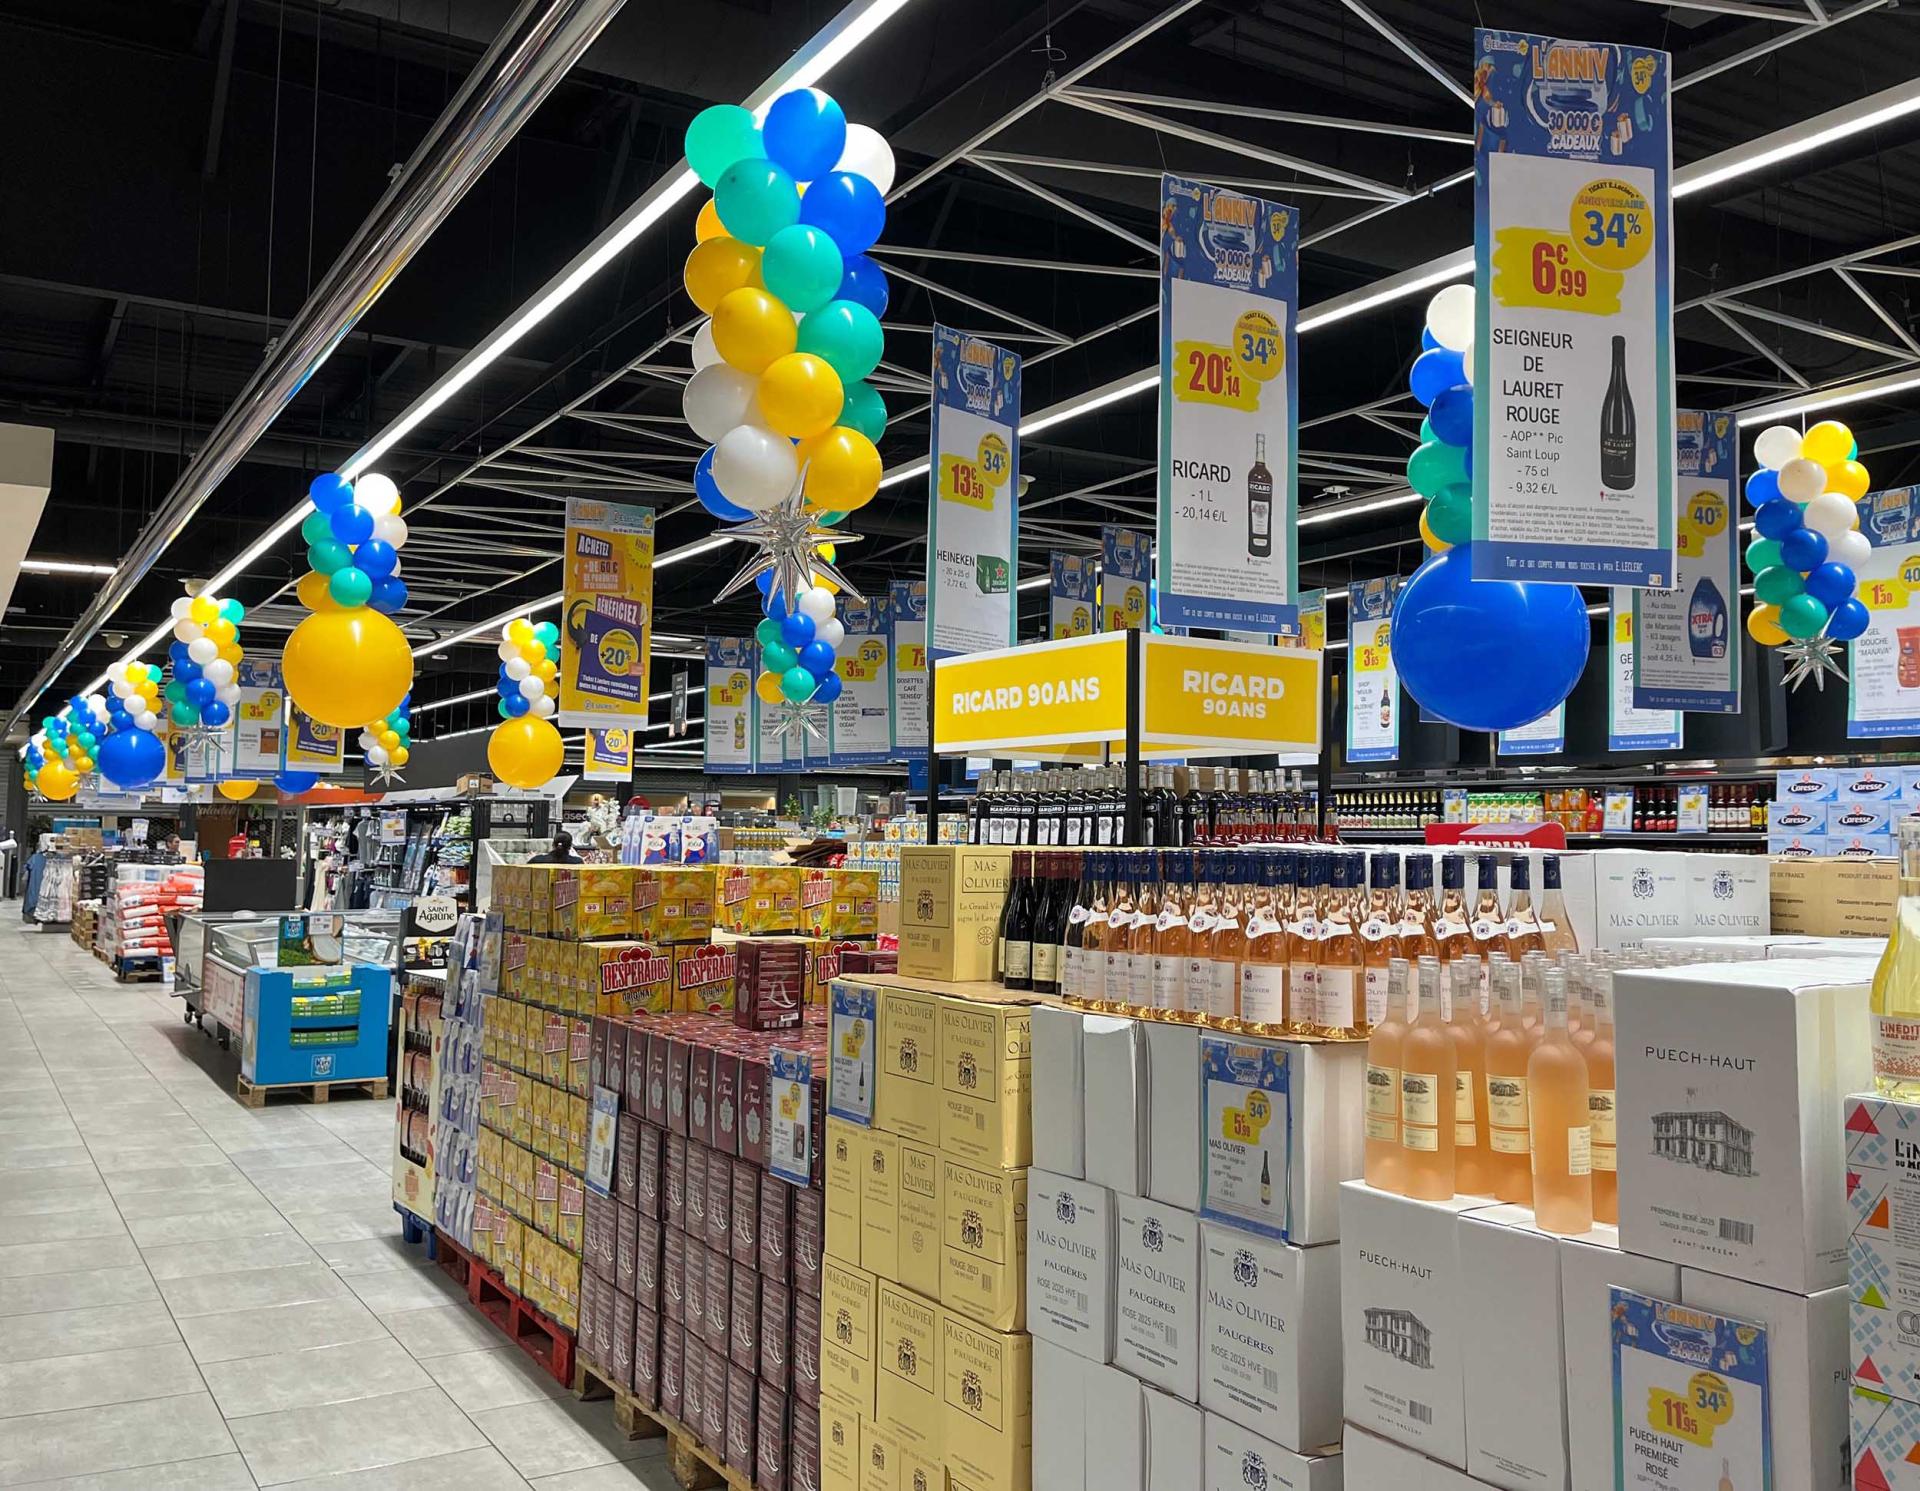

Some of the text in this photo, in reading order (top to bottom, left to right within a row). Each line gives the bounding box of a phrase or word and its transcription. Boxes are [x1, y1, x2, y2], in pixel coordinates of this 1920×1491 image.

[1549, 111, 1602, 131] 30 000 €
[1551, 133, 1601, 152] CADEAUX
[1584, 210, 1642, 248] 34%
[1215, 268, 1252, 283] CADEAUX
[1240, 333, 1277, 364] 34%
[1493, 328, 1573, 349] SEIGNEUR
[1523, 356, 1544, 372] DE
[1503, 380, 1563, 399] LAURET
[1506, 406, 1560, 424] ROUGE
[1547, 431, 1564, 444] Pic
[983, 450, 1006, 474] 34%
[1506, 447, 1560, 463] Saint Loup
[1173, 460, 1231, 483] RICARD
[1524, 465, 1549, 477] 75 cl
[1207, 490, 1213, 502] L
[1516, 482, 1558, 496] 9,32 €/L
[1182, 506, 1227, 523] 20,14 €/L
[1693, 505, 1722, 526] 40%
[578, 535, 610, 557] ACHETEZ
[937, 549, 975, 567] HEINEKEN
[596, 597, 638, 624] BÉNÉFICIEZ
[1691, 612, 1713, 625] XTRA
[590, 633, 598, 644] DE
[1860, 638, 1888, 647] DOUCHE
[1183, 670, 1285, 700] RICARD
[953, 676, 1100, 715] RICARD 90ANS
[1203, 700, 1267, 719] 90ANS
[905, 859, 949, 870] MAS OLIVIER
[974, 860, 998, 871] MAS
[965, 877, 1009, 888] OLIVIER
[418, 910, 455, 922] Agaune
[968, 902, 989, 910] Grand
[1610, 914, 1679, 927] MAS OLIVIER
[1695, 914, 1760, 927] MAS OLIVIER
[603, 957, 670, 992] DESPERADOS
[680, 954, 737, 987] DESPERADO
[887, 1001, 933, 1020] MAS OLIVIER
[944, 1013, 993, 1034] MAS OLIVIER
[1645, 1046, 1757, 1072] PUECH-HAUT
[1209, 1138, 1246, 1155] MAS OLIVIER
[910, 1156, 927, 1169] MAS
[904, 1172, 935, 1192] OLIVIER
[946, 1167, 1002, 1195] MAS OLIVIER
[1036, 1229, 1097, 1260] MAS OLIVIER
[1044, 1260, 1087, 1281] FAUGÈRES
[1120, 1256, 1186, 1293] MAS OLIVIER
[1359, 1250, 1433, 1280] PUECH-HAUT
[826, 1268, 869, 1299] MAS OLIVIER
[883, 1293, 934, 1327] MAS OLIVIER
[1129, 1288, 1176, 1314] FAUGÈRES
[1208, 1289, 1285, 1333] MAS OLIVIER
[945, 1325, 1000, 1361] MAS OLIVIER
[1218, 1325, 1275, 1355] FAUGÈRES
[1211, 1344, 1262, 1374] ROSE 2025 HVE
[1696, 1387, 1727, 1413] 34%
[1629, 1426, 1684, 1454] PUECH HAUT
[1634, 1443, 1679, 1469] PREMIÈRE
[1645, 1462, 1668, 1480] ROSÉ
